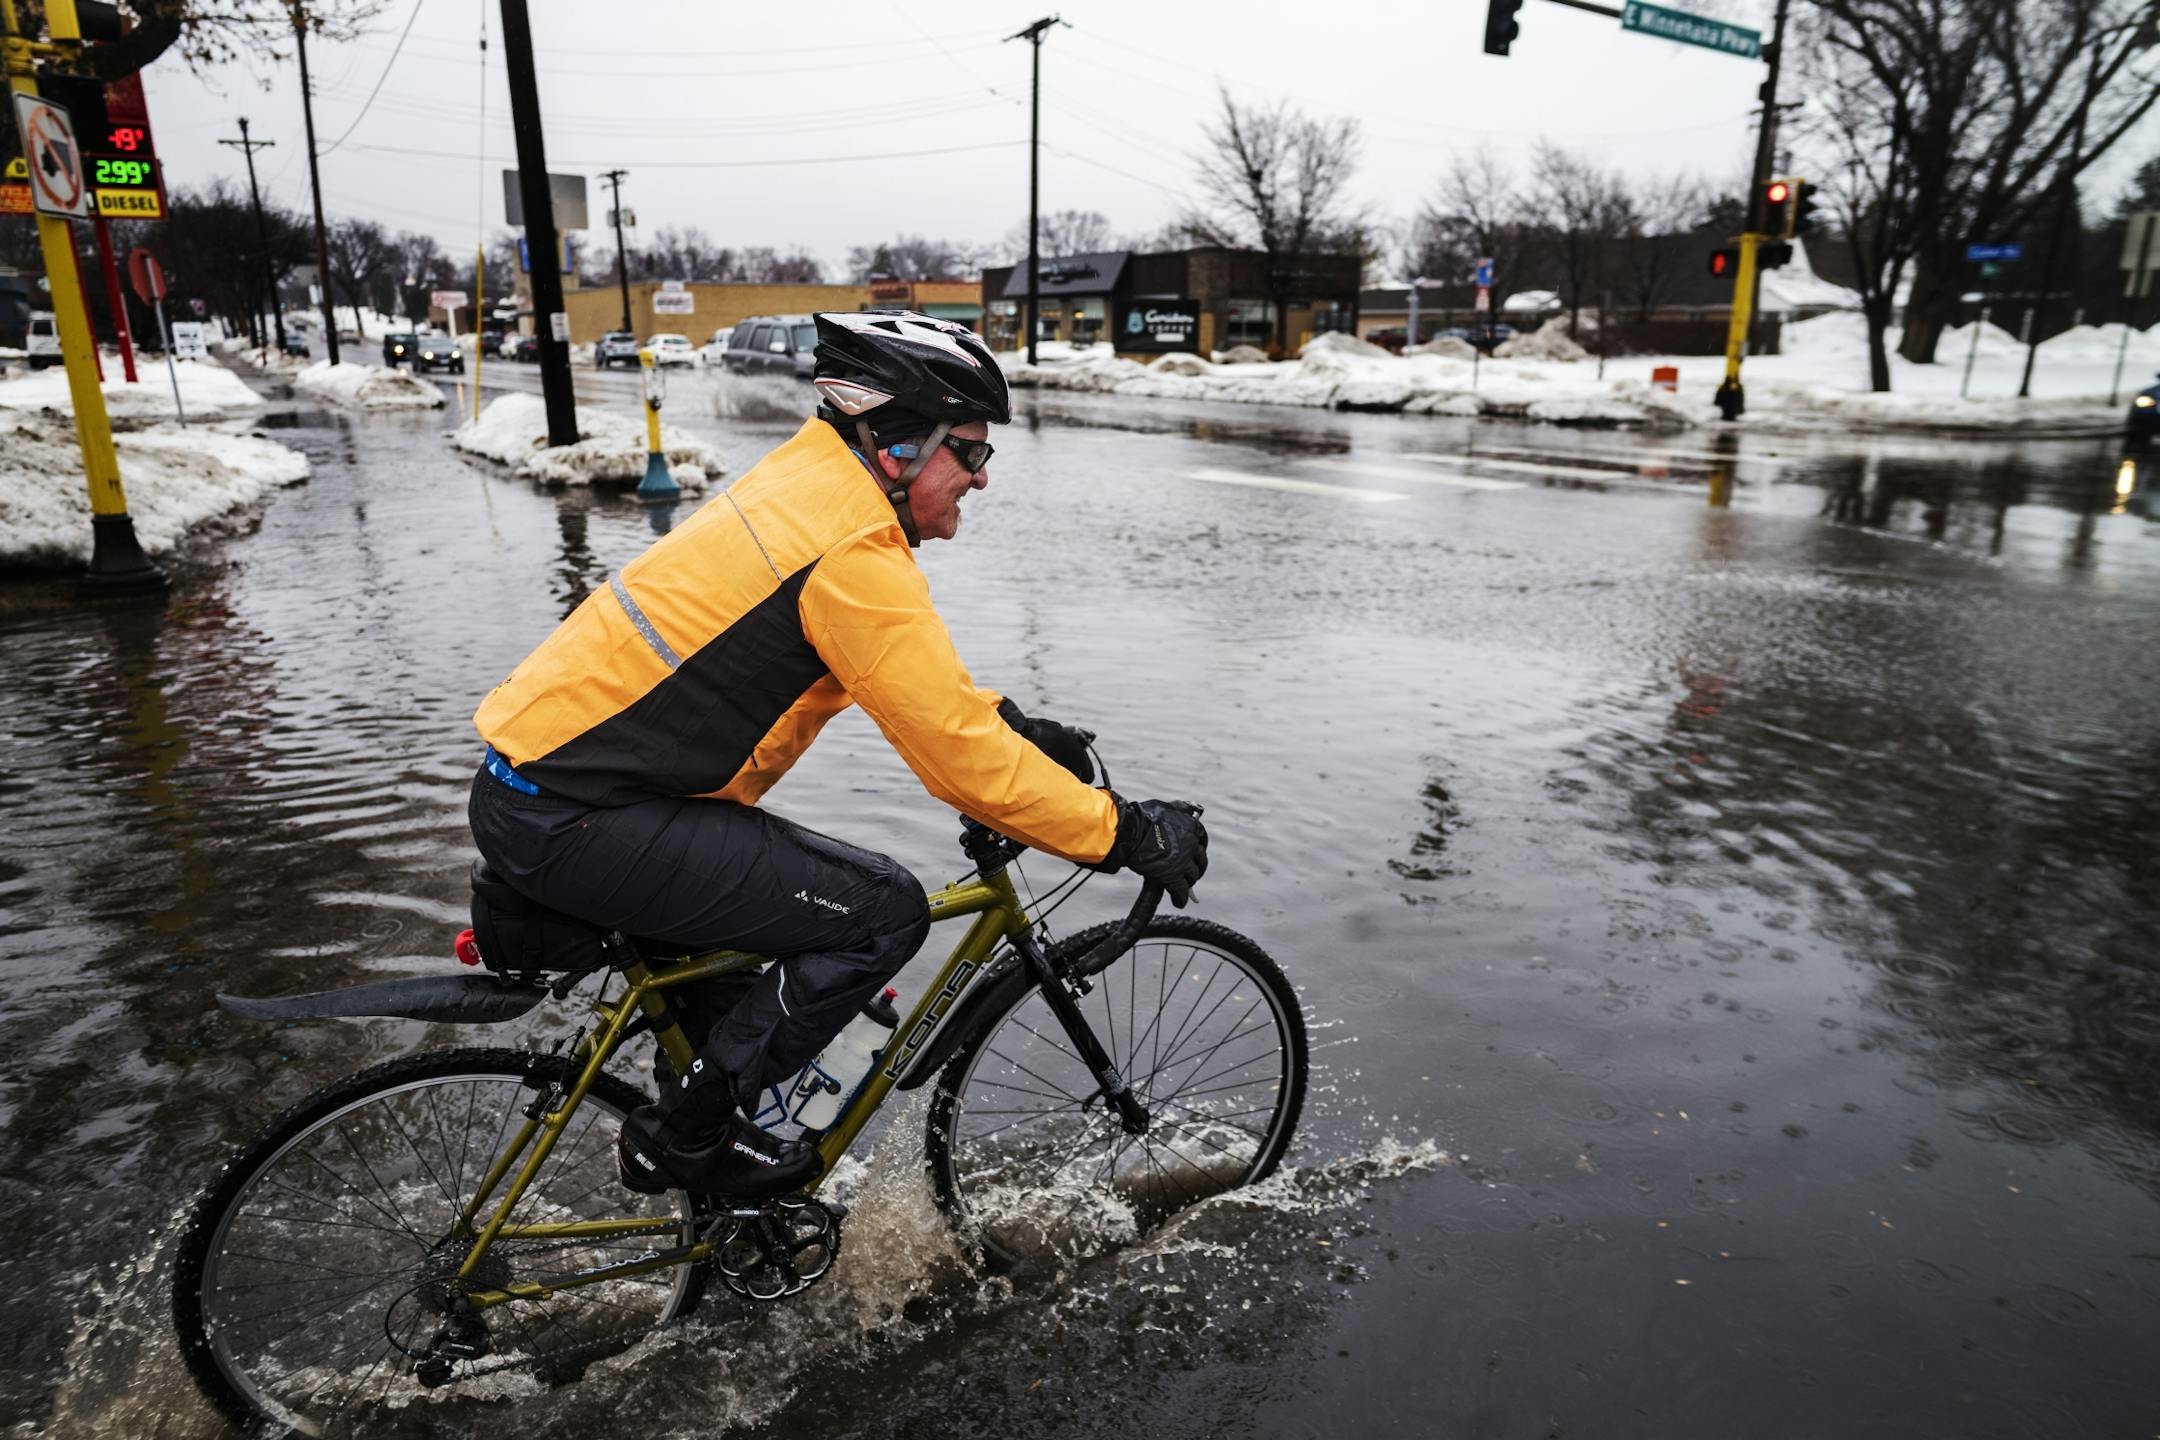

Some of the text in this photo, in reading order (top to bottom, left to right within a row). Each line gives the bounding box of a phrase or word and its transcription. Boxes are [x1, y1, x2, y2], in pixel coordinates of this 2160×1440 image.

[1624, 3, 1638, 26] E
[102, 195, 157, 211] DIESEL
[1147, 324, 1193, 334] COFFEE
[813, 895, 850, 915] VAUDE
[733, 1140, 778, 1166] GARNEAU
